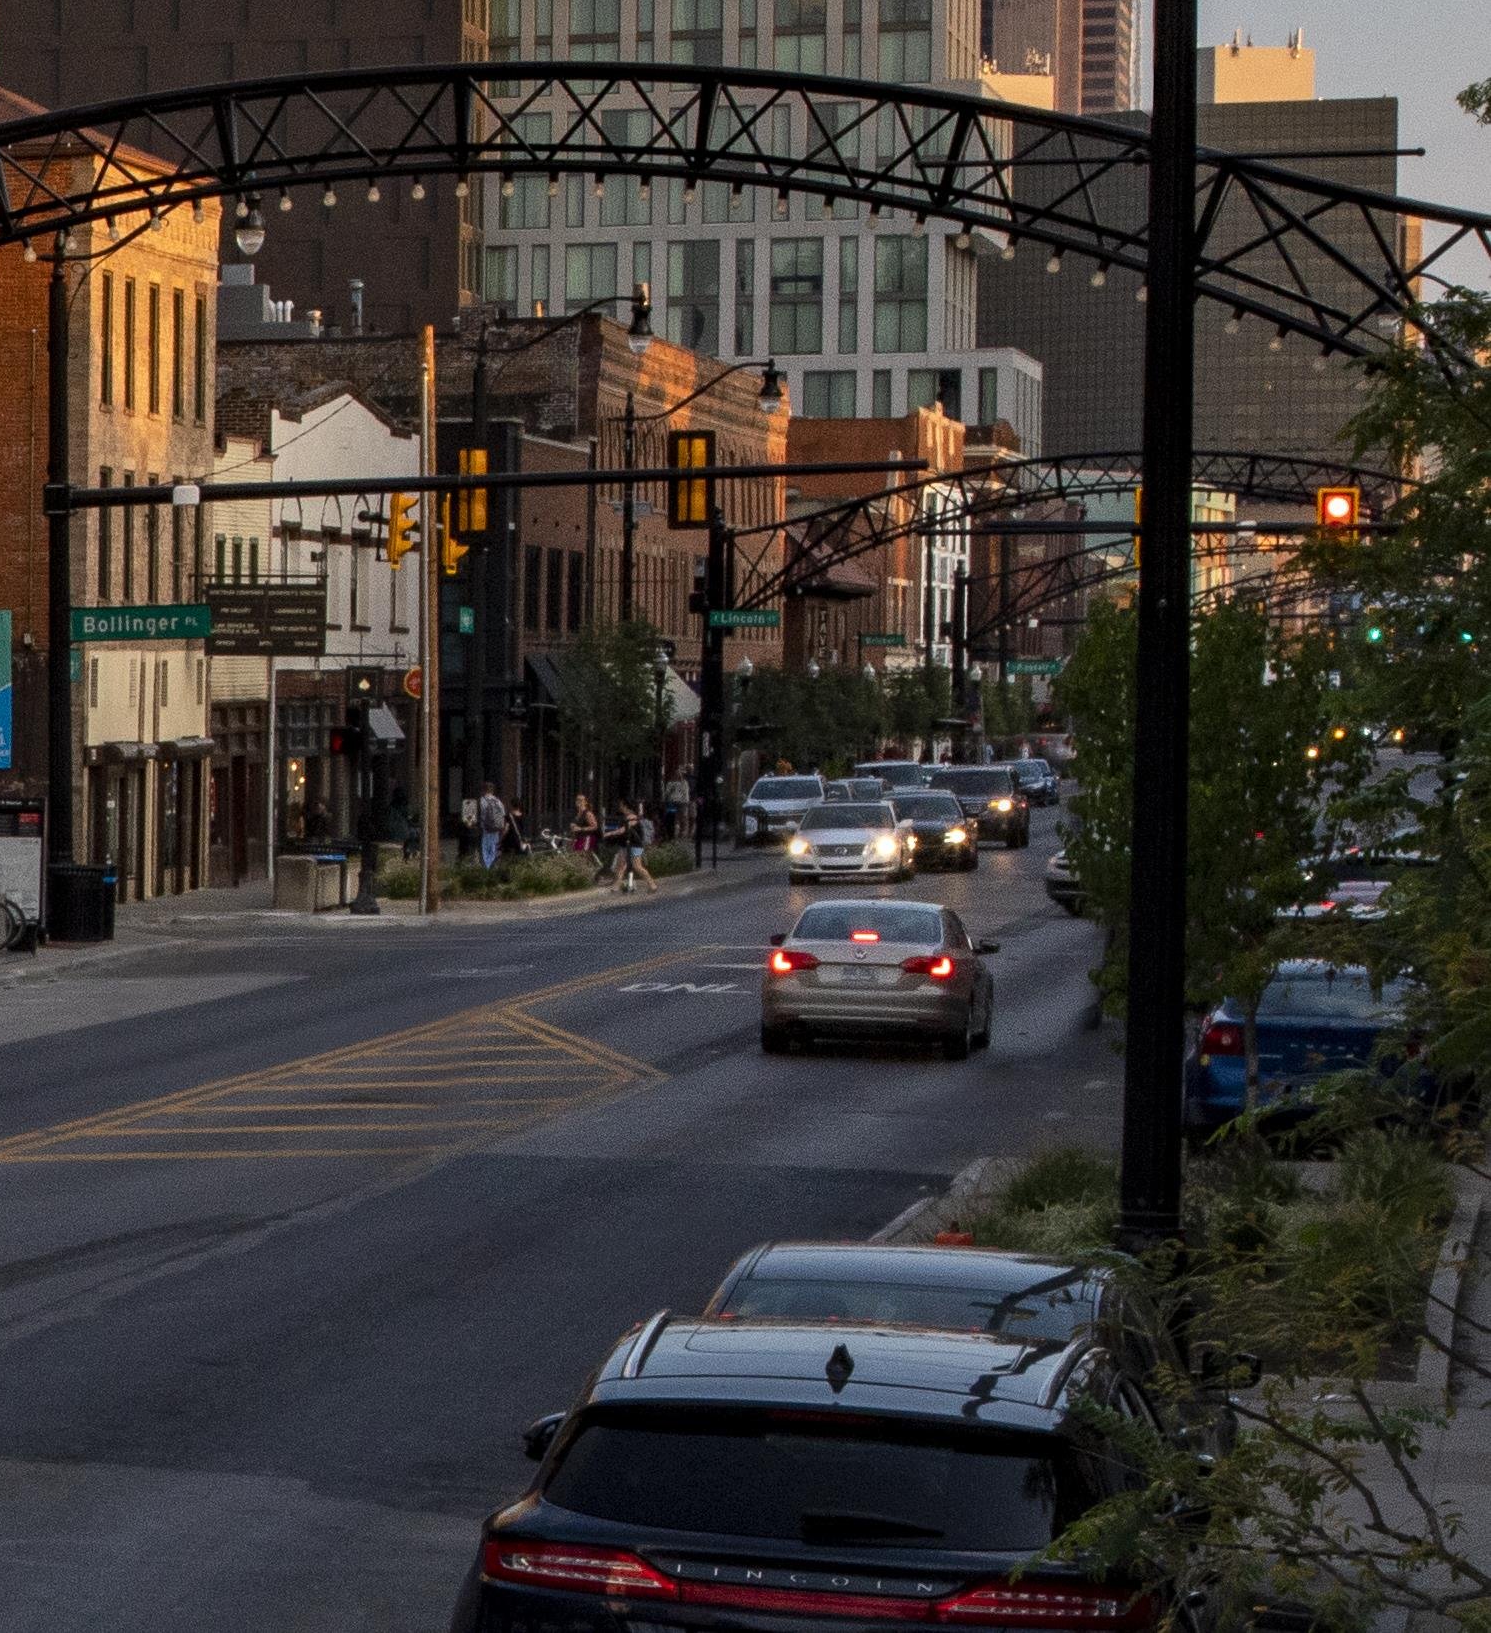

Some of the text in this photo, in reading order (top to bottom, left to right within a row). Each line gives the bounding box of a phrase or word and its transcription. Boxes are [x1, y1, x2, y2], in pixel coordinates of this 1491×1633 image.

[83, 615, 179, 635] Bollinger
[720, 612, 766, 624] Lincoln
[676, 1564, 934, 1593] LINCOLN
